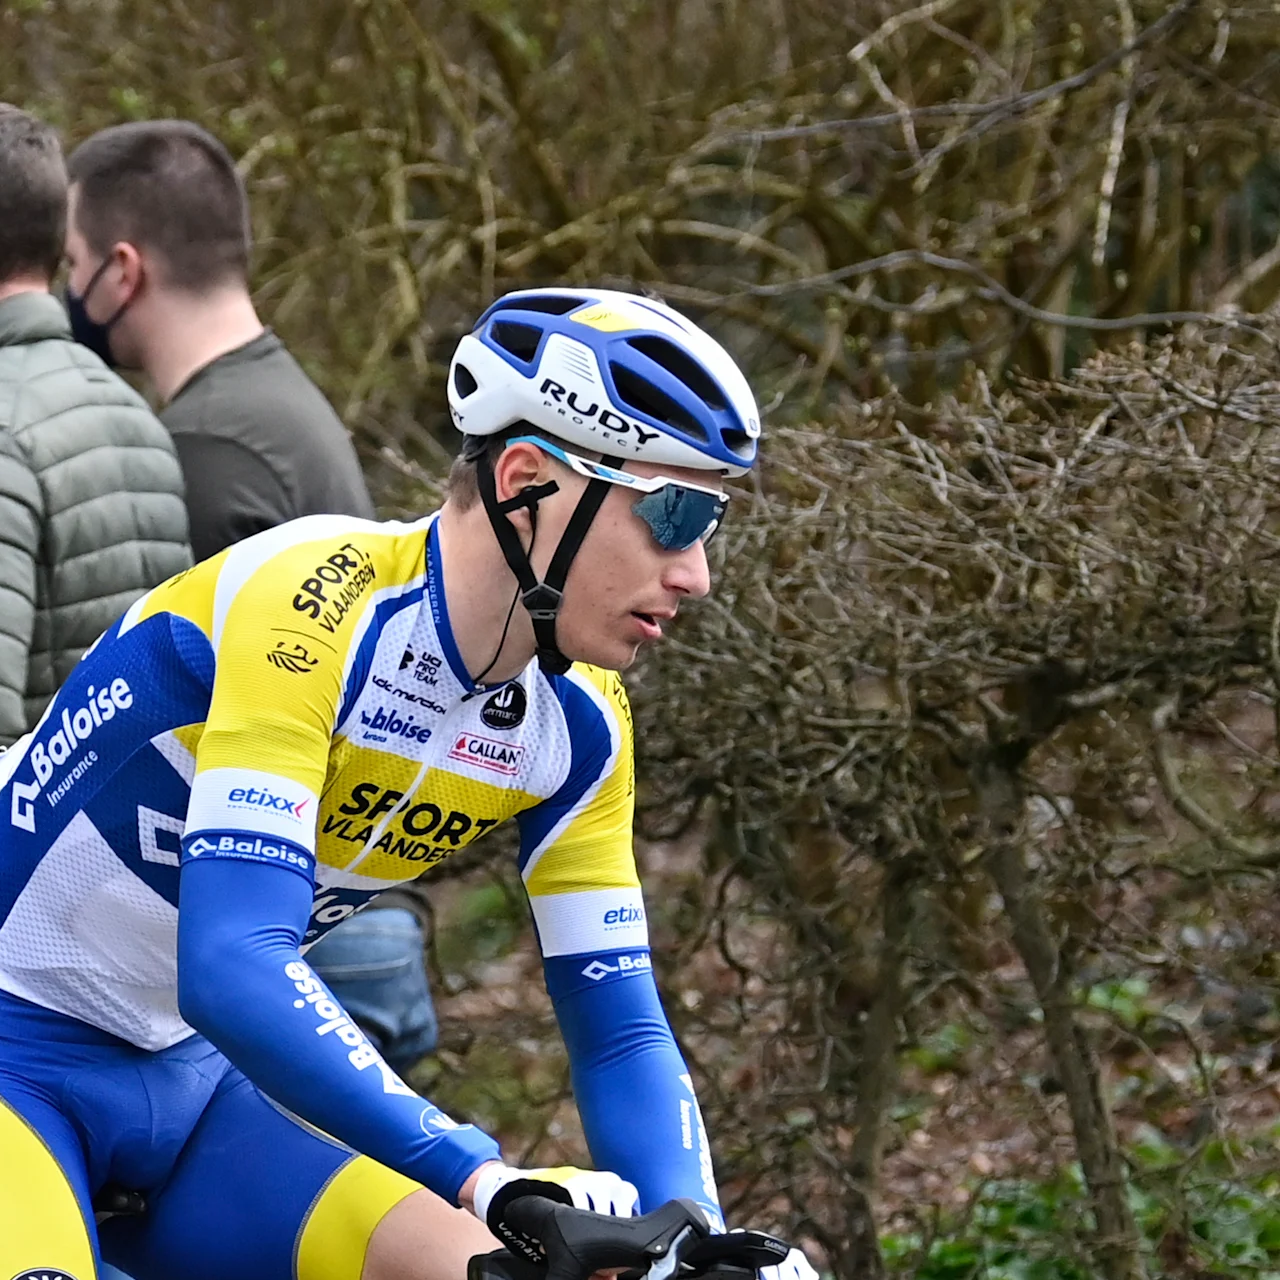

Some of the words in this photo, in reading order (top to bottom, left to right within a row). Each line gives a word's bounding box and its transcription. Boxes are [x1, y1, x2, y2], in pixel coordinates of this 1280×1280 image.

[539, 378, 660, 446] RUDY
[543, 400, 644, 453] PROJECT
[318, 564, 377, 634] VLAANDEREN
[413, 671, 440, 688] TEAM
[416, 661, 438, 676] PRO
[421, 651, 442, 669] UCI
[30, 676, 134, 788] Baloise
[467, 740, 520, 765] CALLAN
[46, 750, 99, 808] Insurance
[227, 786, 296, 815] etixx
[218, 836, 309, 870] Baloise
[283, 961, 378, 1071] Baloise
[498, 1221, 542, 1263] vermarc
